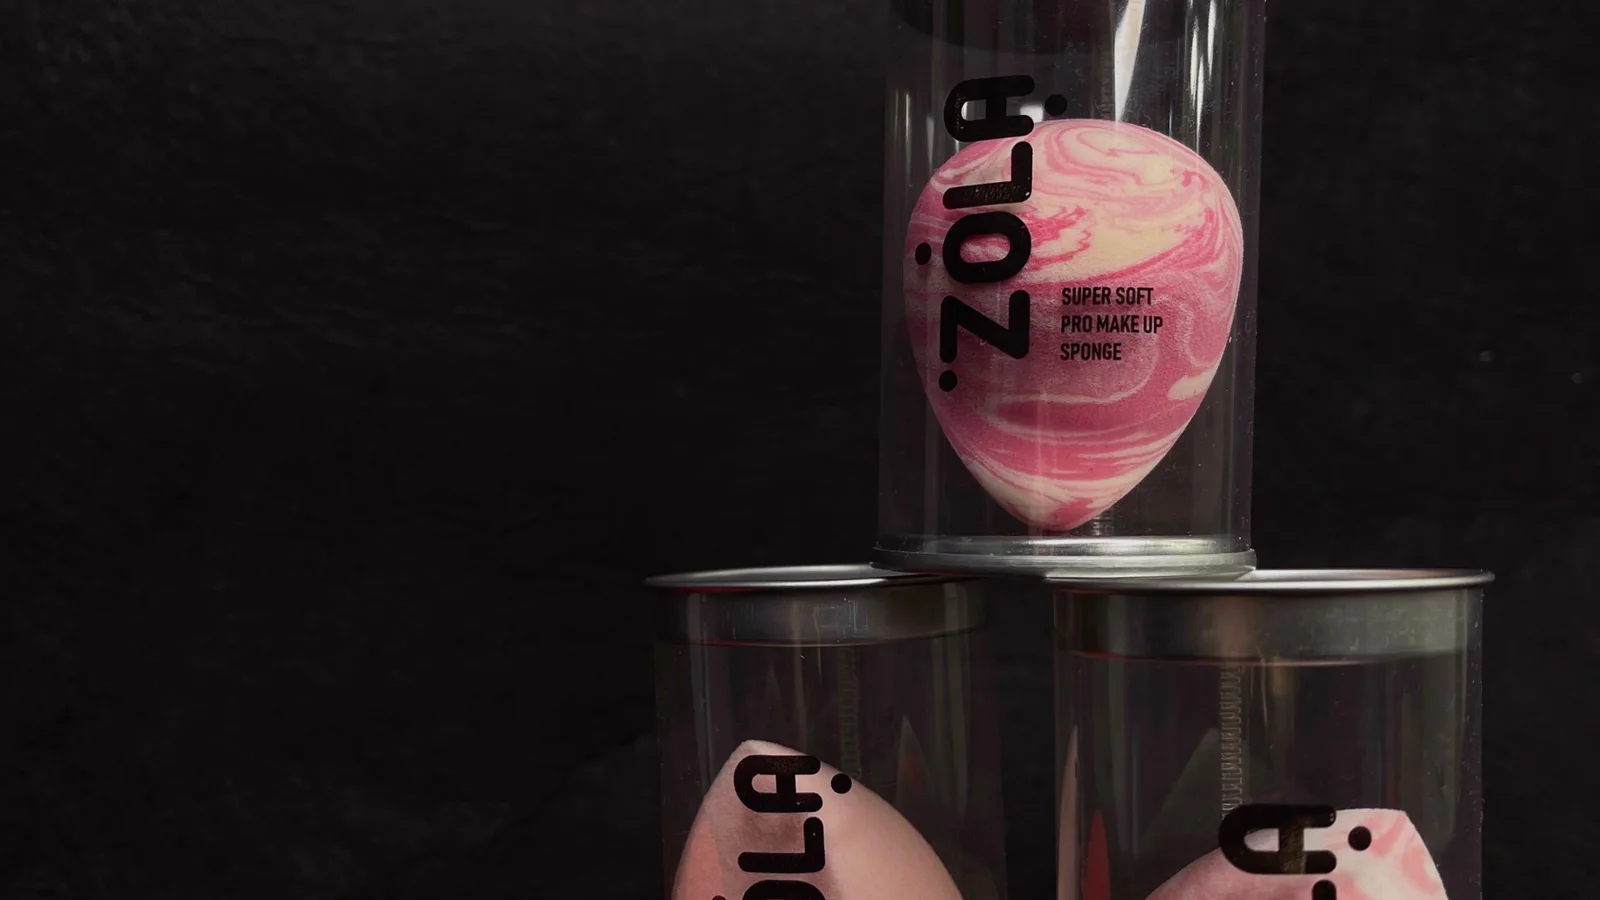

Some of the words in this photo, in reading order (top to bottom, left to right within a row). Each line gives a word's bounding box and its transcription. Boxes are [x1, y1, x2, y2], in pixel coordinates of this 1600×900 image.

[1061, 287, 1111, 305] SUPER
[1115, 287, 1154, 305] SOFT
[1061, 314, 1093, 333] PRO
[1096, 315, 1139, 333] MAKE
[1143, 315, 1163, 334] UP
[1060, 342, 1122, 361] SPONGE
